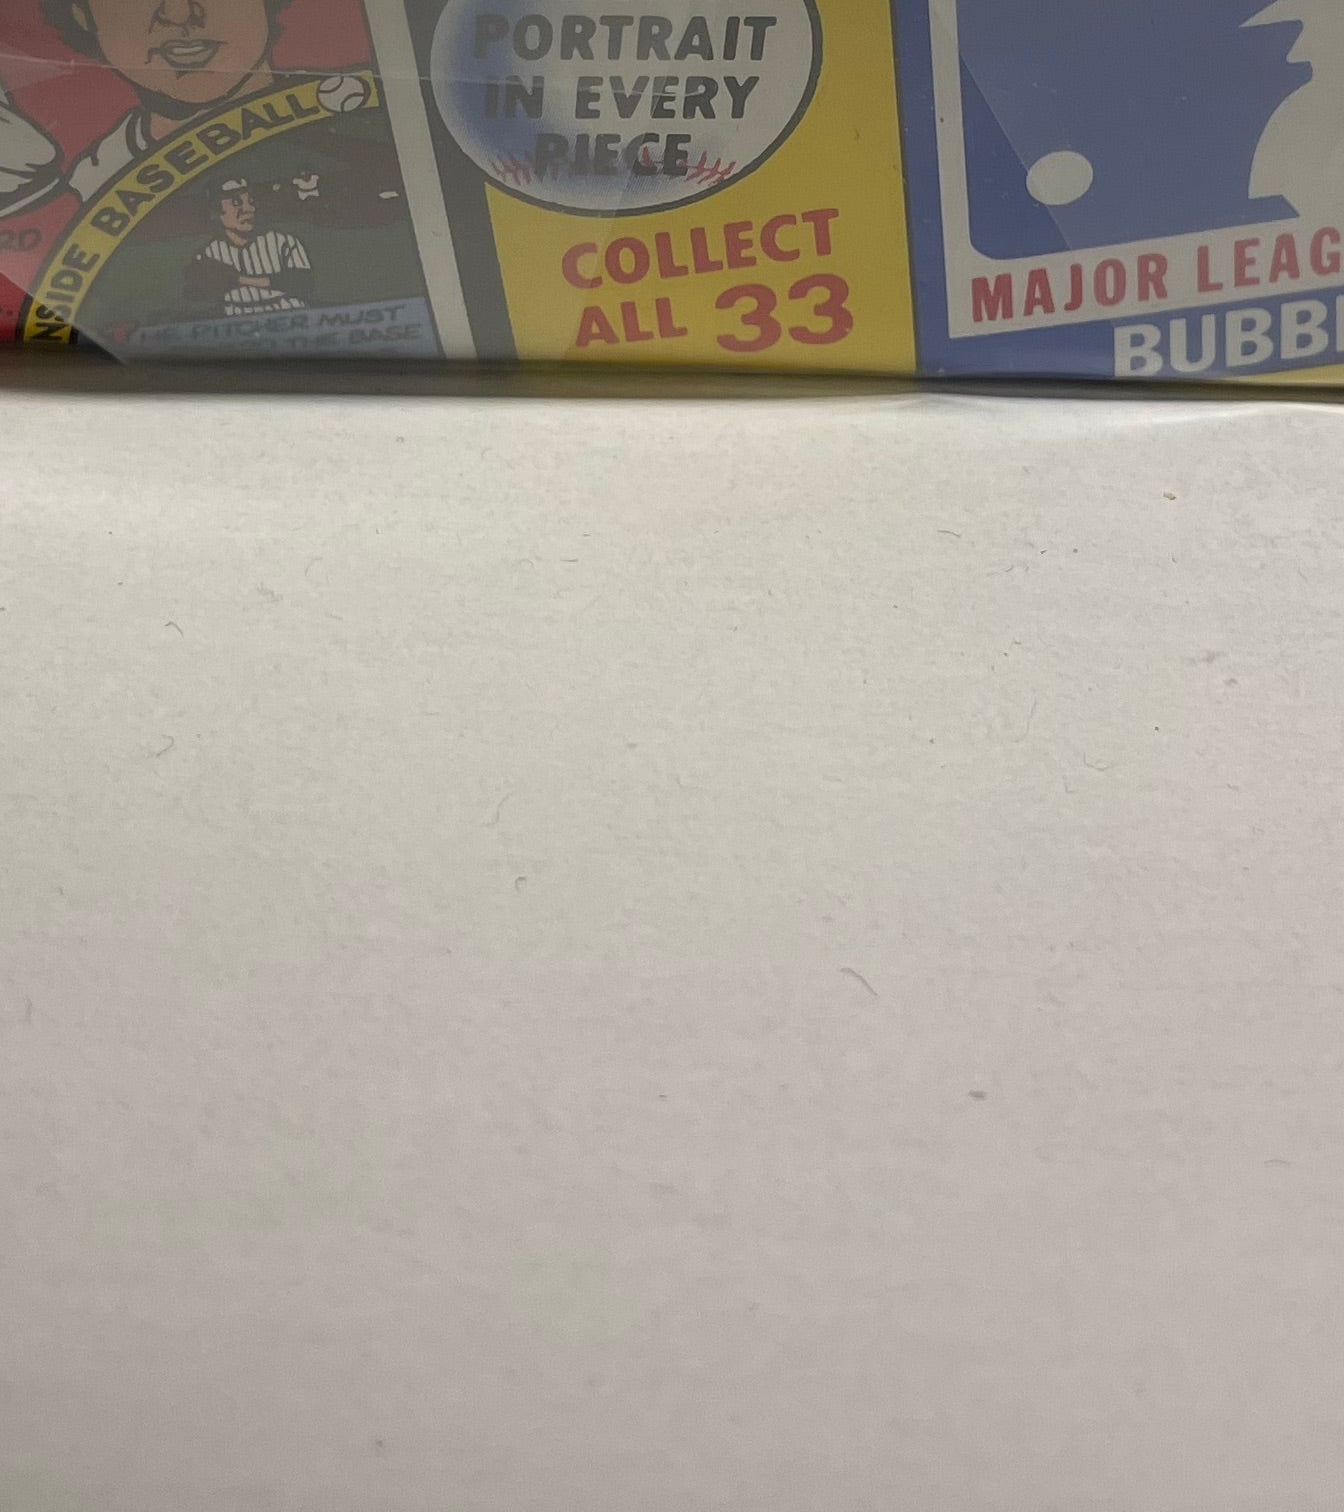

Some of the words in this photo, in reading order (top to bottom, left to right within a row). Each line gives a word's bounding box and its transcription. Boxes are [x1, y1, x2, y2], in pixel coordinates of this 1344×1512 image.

[473, 14, 777, 61] PORTRAIT
[483, 75, 545, 120] IN
[574, 75, 760, 120] EVERY
[533, 132, 692, 178] PIECE
[32, 243, 101, 341] NSIDE
[90, 88, 320, 237] BASEBALL
[561, 208, 840, 288] COLLECT
[318, 304, 406, 325] MUST
[575, 297, 688, 348] ALL
[715, 273, 854, 353] 33
[971, 253, 1168, 323] MAJOR
